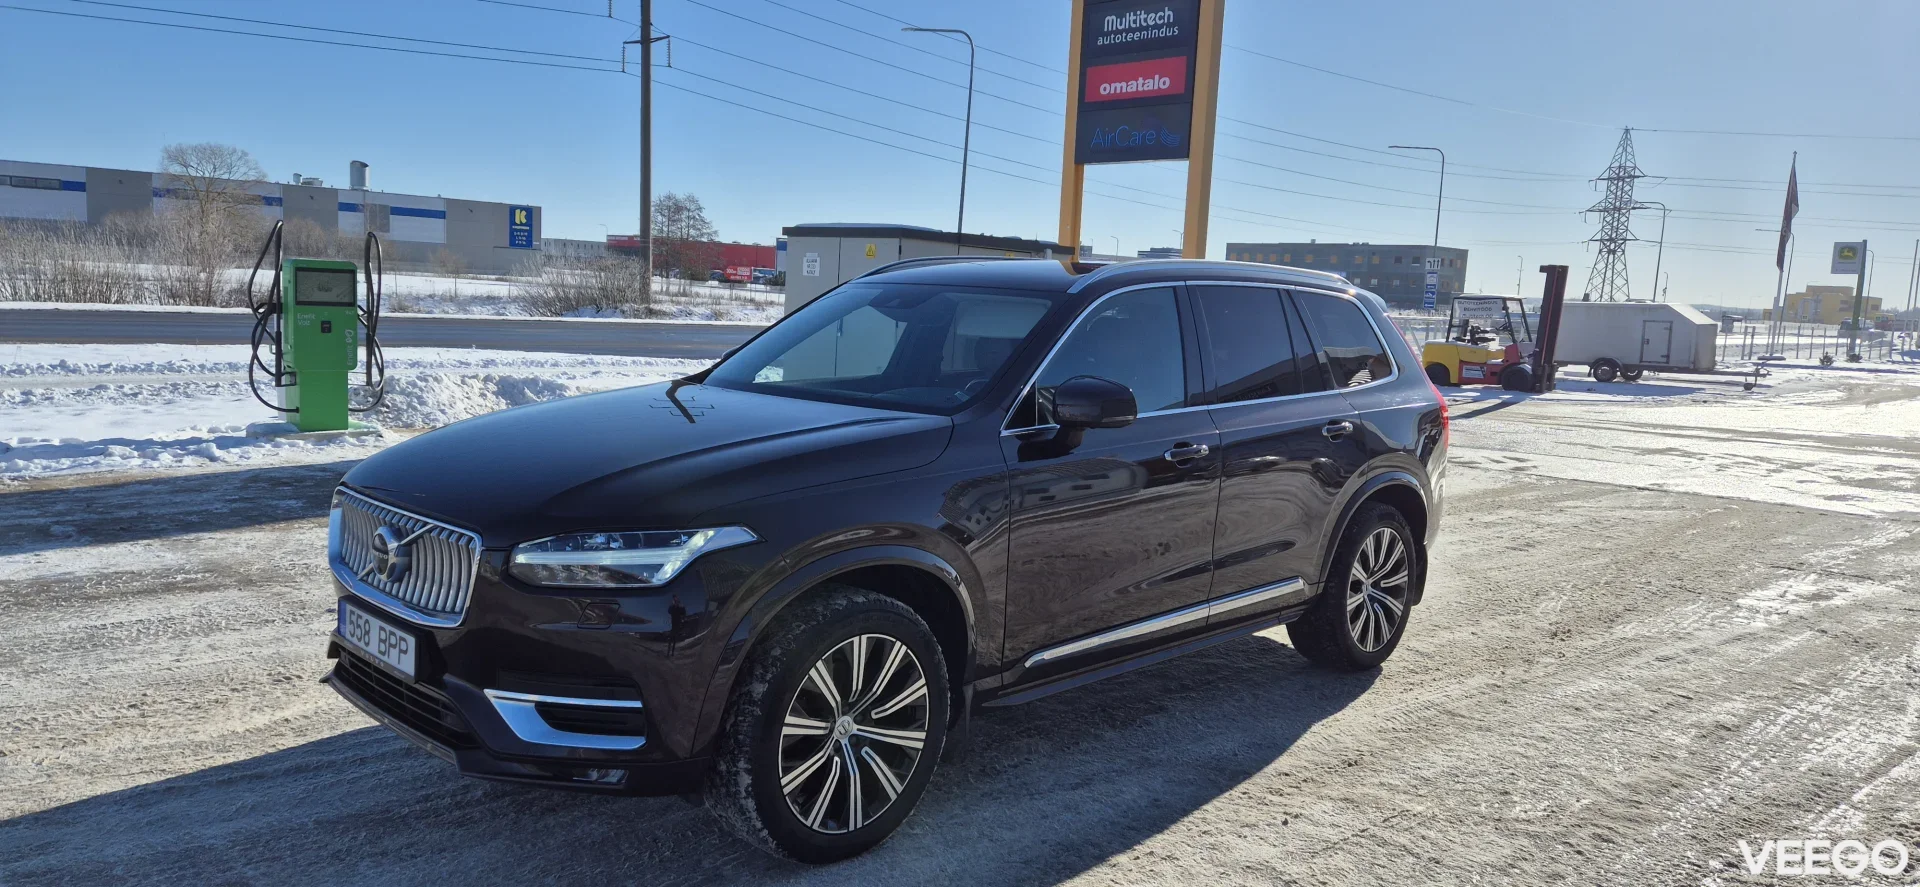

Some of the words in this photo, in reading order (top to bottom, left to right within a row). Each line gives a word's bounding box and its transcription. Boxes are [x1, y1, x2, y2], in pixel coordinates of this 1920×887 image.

[1103, 7, 1174, 32] Multitech
[1097, 25, 1179, 46] autoteenindus
[1099, 74, 1170, 95] omatalo
[1090, 125, 1157, 148] AirCare
[348, 609, 371, 648] 558
[377, 624, 409, 665] BPP
